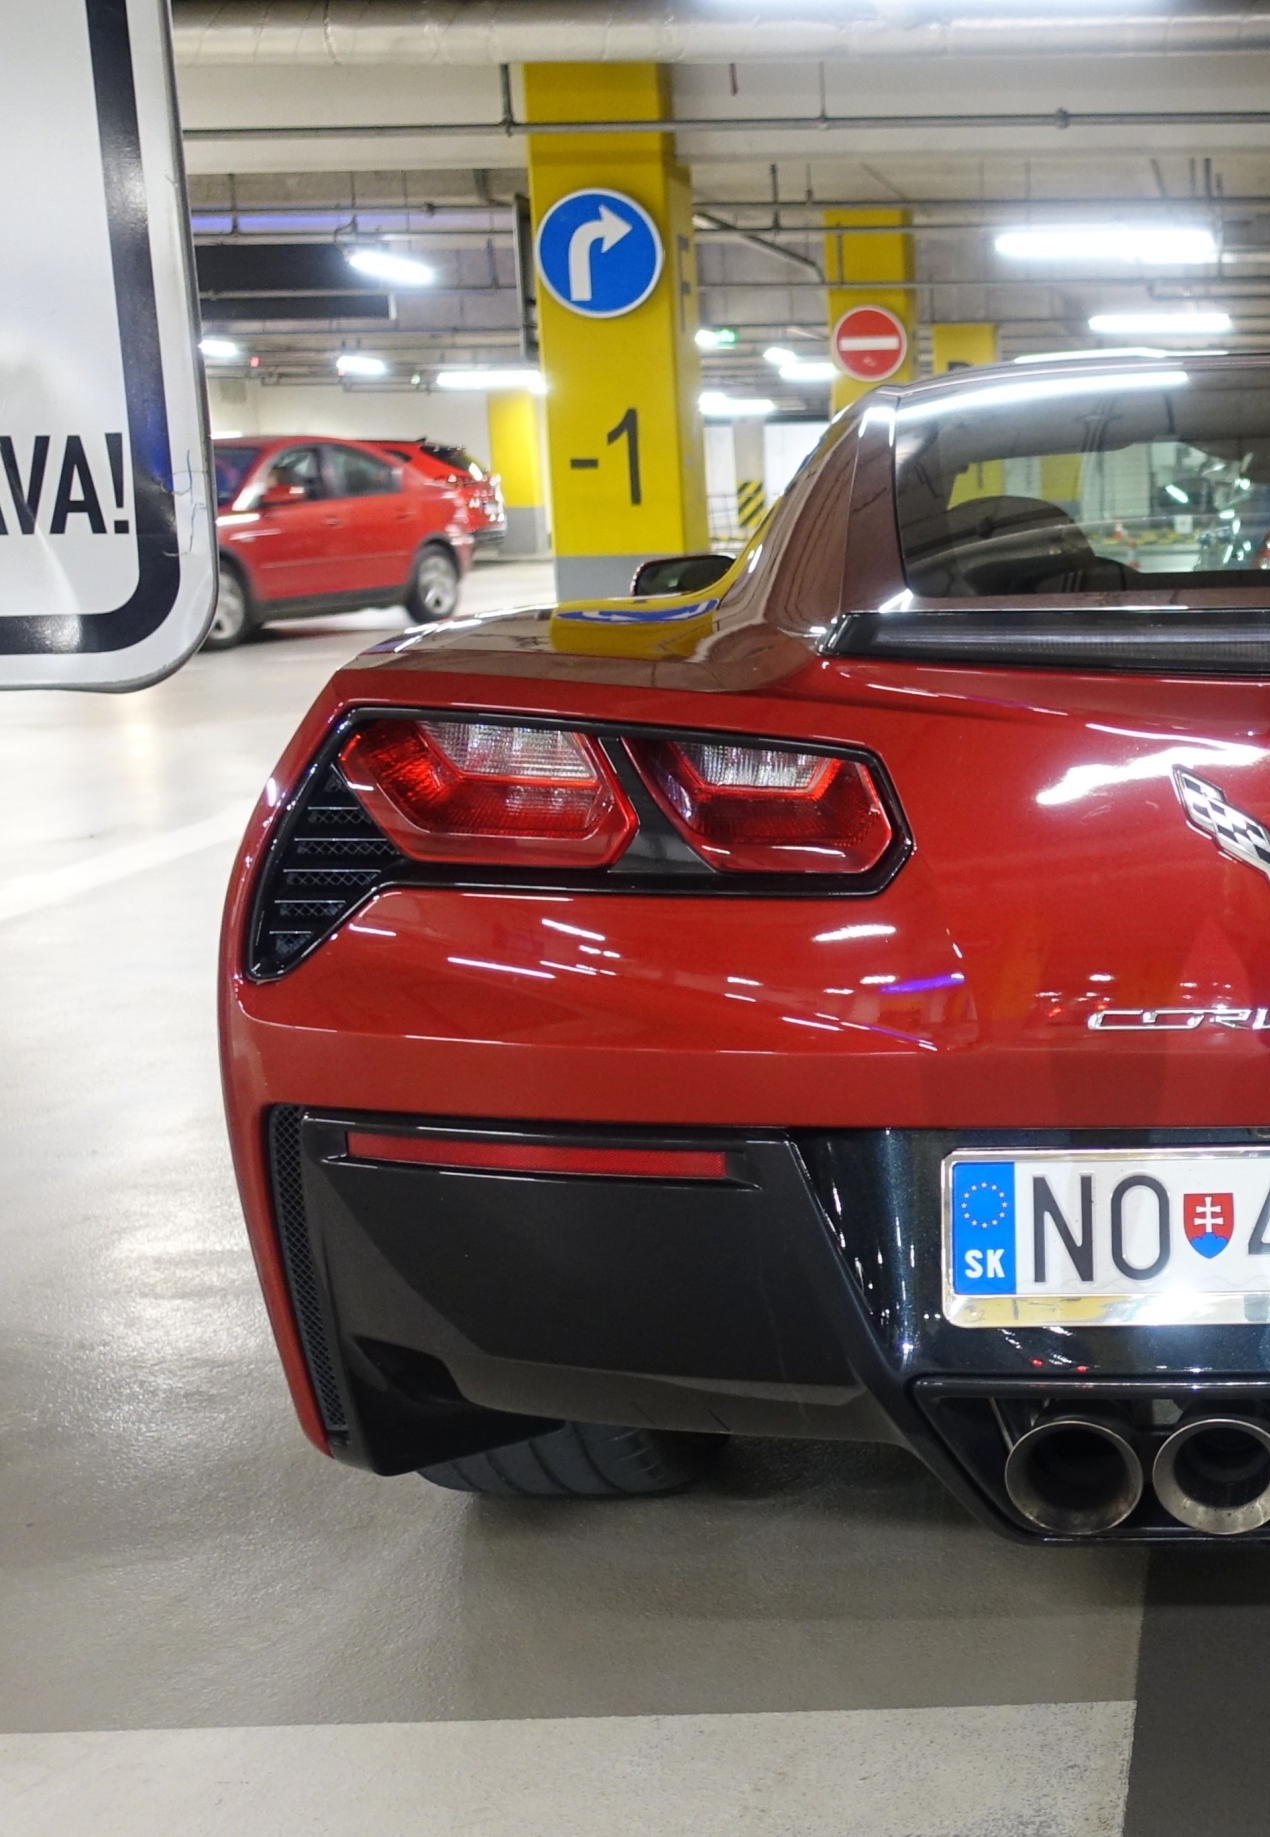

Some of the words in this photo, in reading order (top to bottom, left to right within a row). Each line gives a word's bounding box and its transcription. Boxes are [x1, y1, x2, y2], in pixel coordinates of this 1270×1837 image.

[0, 432, 129, 535] VA!
[569, 407, 641, 506] -1
[964, 1248, 1005, 1279] SK
